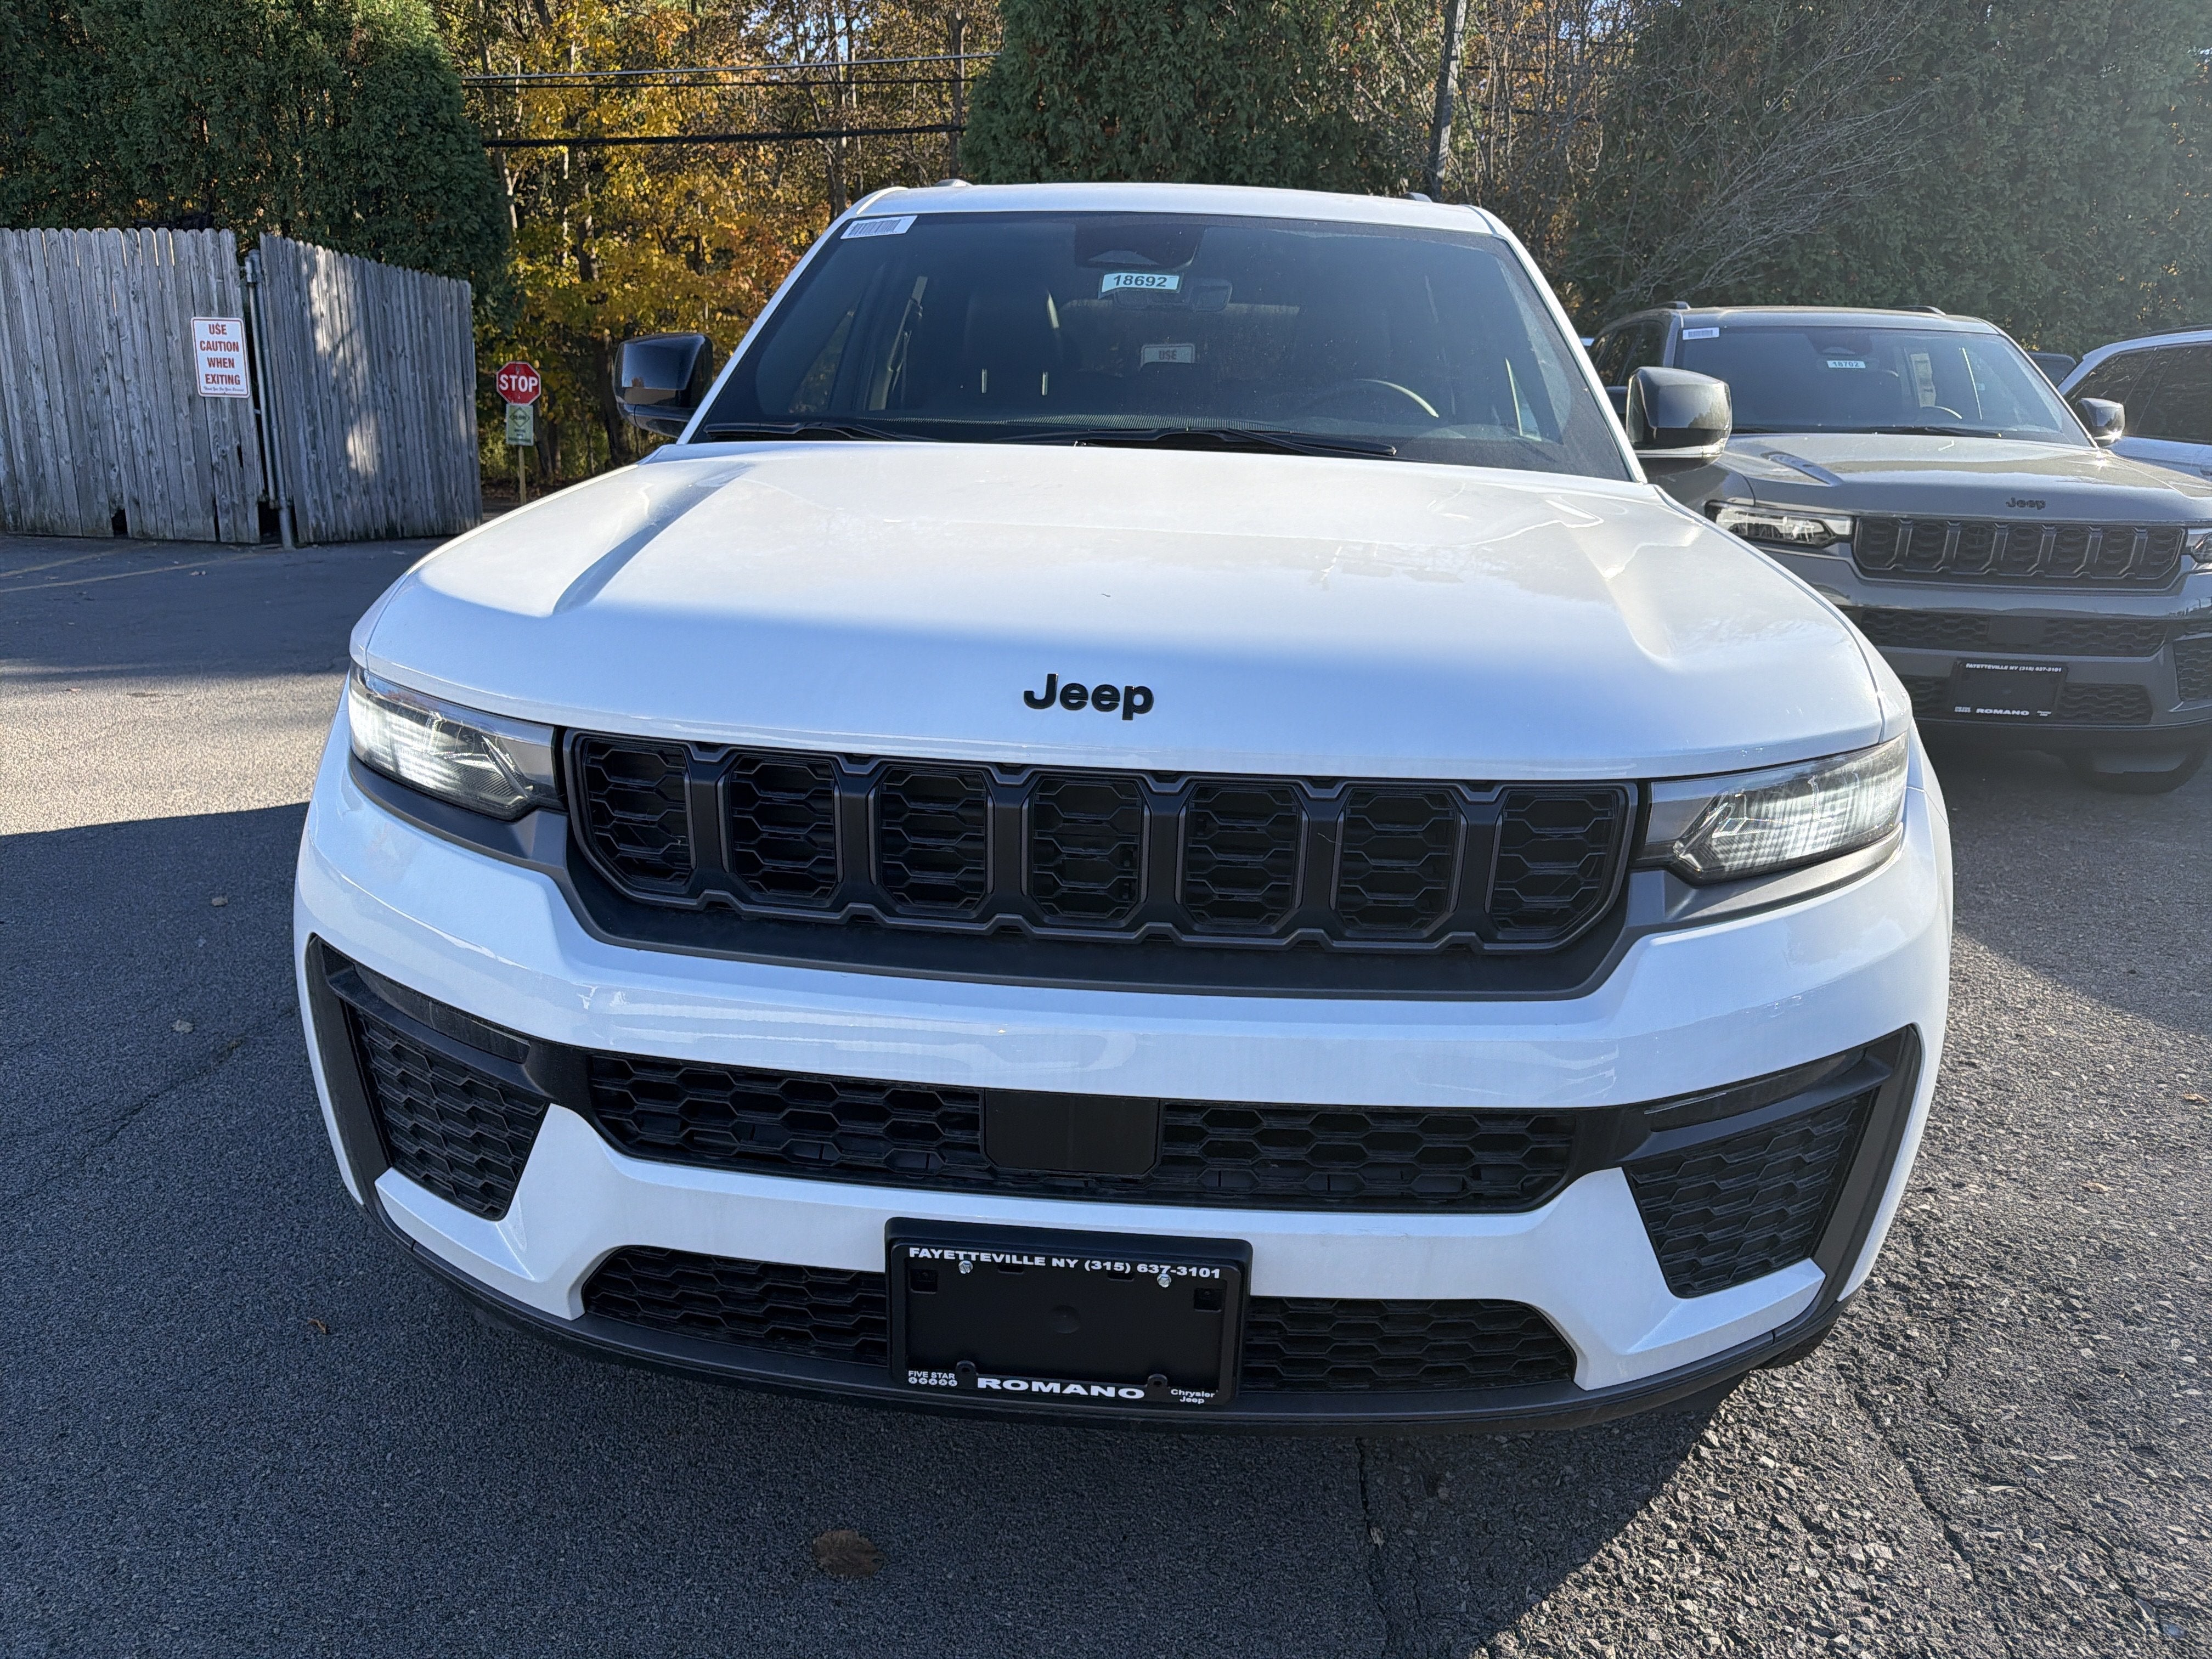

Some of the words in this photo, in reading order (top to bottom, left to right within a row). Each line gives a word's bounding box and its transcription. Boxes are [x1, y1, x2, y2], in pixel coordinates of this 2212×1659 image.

[1113, 275, 1167, 287] 18692
[208, 324, 227, 335] USE
[200, 340, 239, 352] CAUTION
[1159, 350, 1177, 360] USE
[207, 357, 235, 369] WHEN
[205, 374, 241, 385] EXITING
[499, 374, 538, 393] STOP
[2005, 496, 2046, 510] Jeep
[1023, 673, 1154, 721] Jeep
[1976, 708, 2030, 716] ROMANO
[909, 1247, 1046, 1266] FAYETTEVILLE
[1052, 1257, 1079, 1268] NY
[1084, 1260, 1131, 1274] (315)
[1137, 1263, 1221, 1279] 637-3101
[908, 1370, 929, 1378] FIVE
[930, 1372, 955, 1380] STAR
[977, 1378, 1145, 1399] ROMANO
[1170, 1389, 1215, 1398] Chrysler
[1180, 1396, 1205, 1404] Jeep
